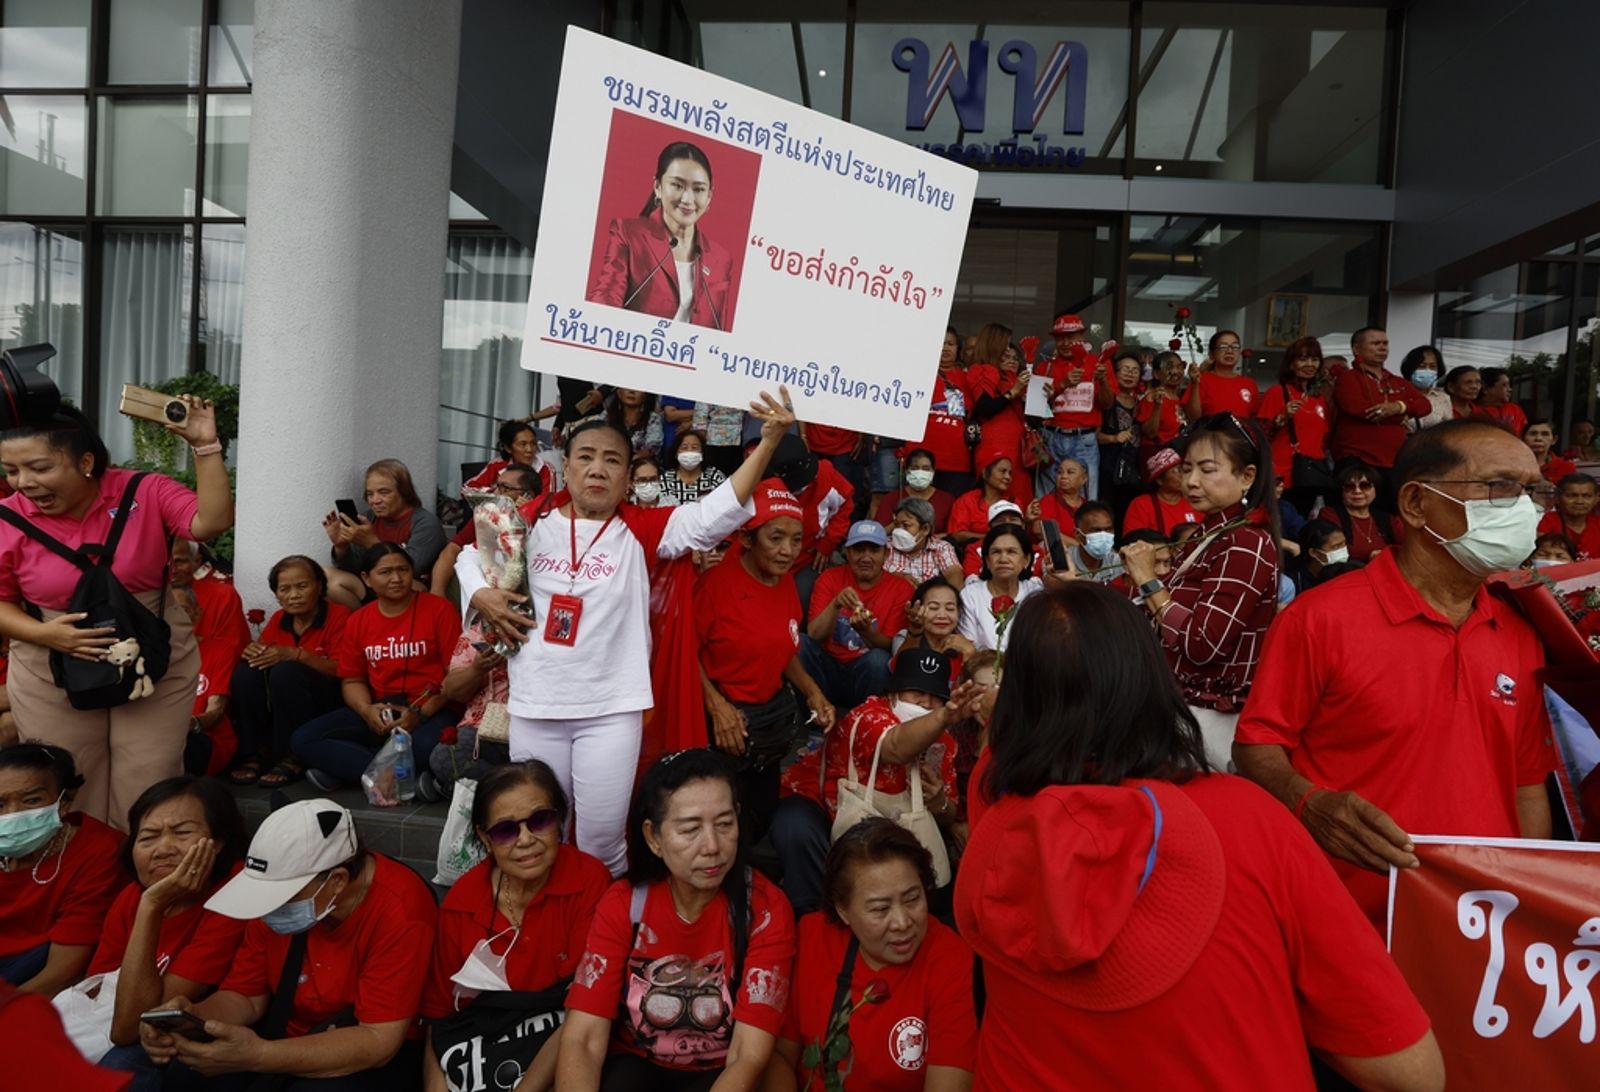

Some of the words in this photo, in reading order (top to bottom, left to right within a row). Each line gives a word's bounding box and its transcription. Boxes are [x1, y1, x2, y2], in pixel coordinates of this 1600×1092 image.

[891, 37, 1088, 135] พท
[603, 75, 955, 212] ชมรมพลังสตรีแห่งประเทศไทย
[546, 304, 699, 364] ให้นายกอิ๊งค์
[708, 344, 925, 410] “นายกหญิงในดวงใจ”
